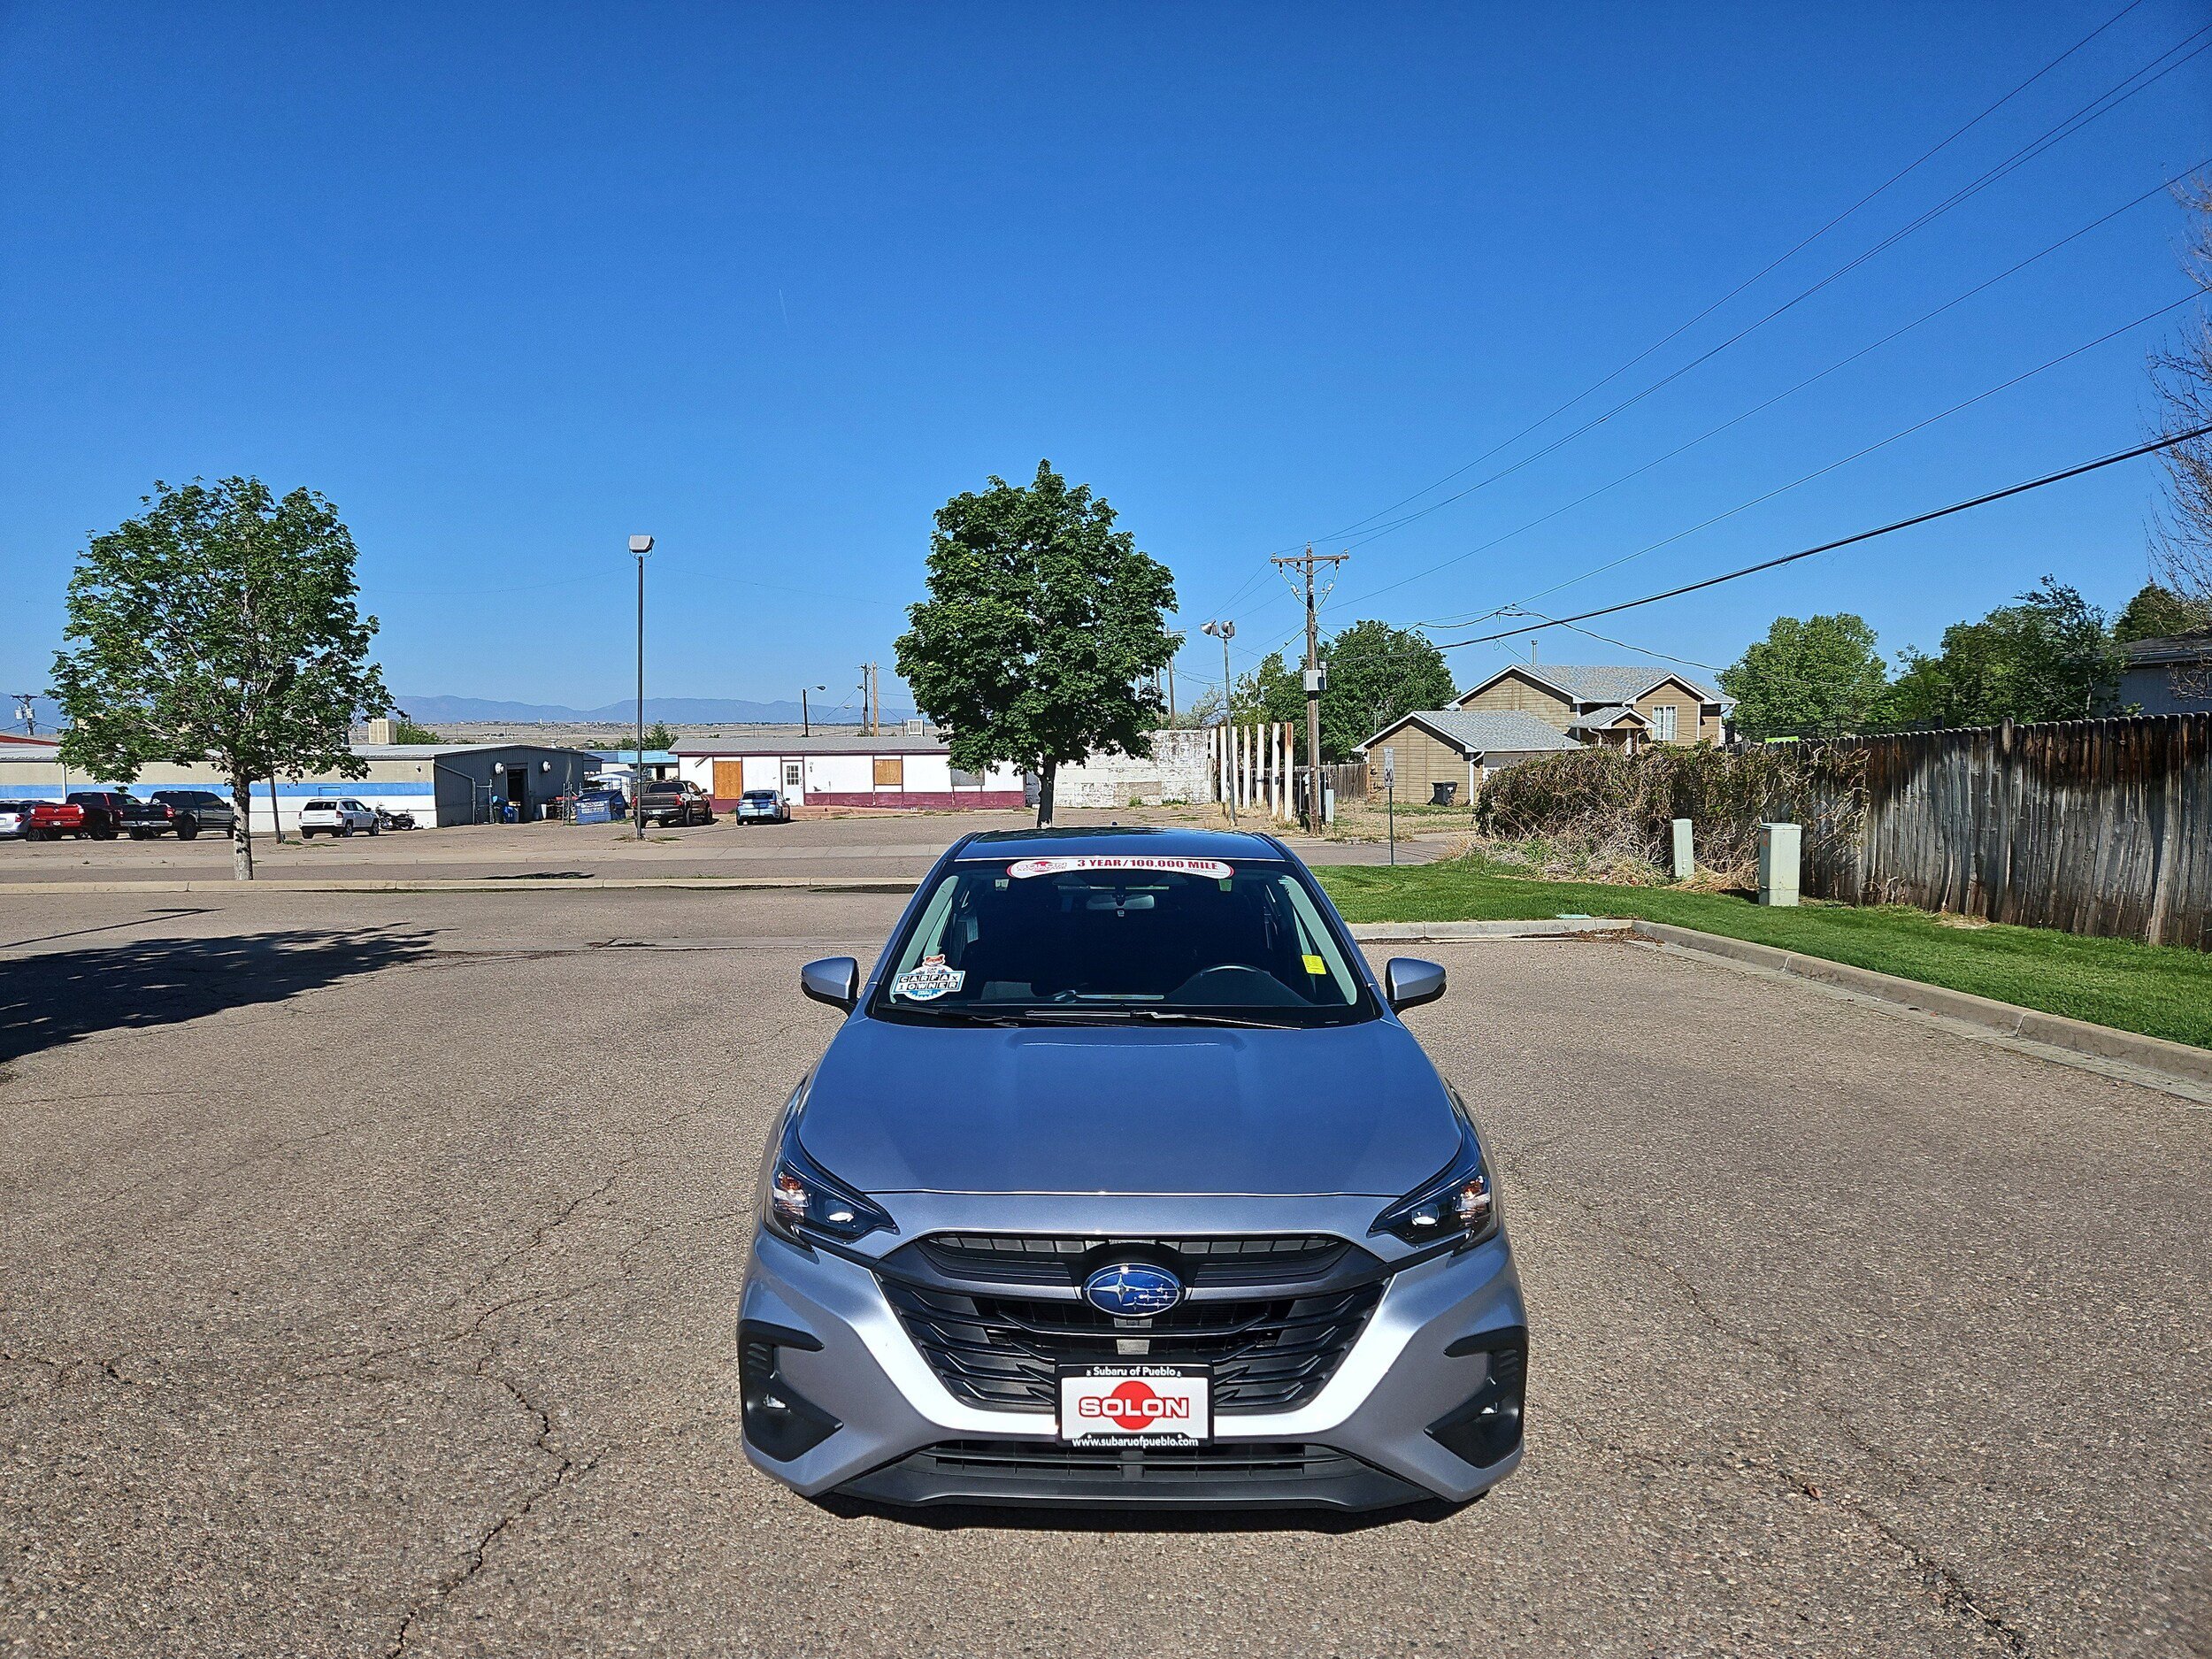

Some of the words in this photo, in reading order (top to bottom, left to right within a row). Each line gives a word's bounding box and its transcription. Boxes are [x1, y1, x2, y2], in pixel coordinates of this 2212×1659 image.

[1089, 859, 1185, 868] YEAR/100,000
[1187, 861, 1219, 870] MILE
[899, 973, 958, 983] CARFAX
[906, 981, 958, 990] OWNER
[1094, 1367, 1128, 1377] Subaru
[1129, 1367, 1141, 1376] of
[1142, 1367, 1176, 1377] Pueblo
[1079, 1396, 1189, 1418] SOLON
[1071, 1435, 1199, 1448] www.subaruofpueblo.com
